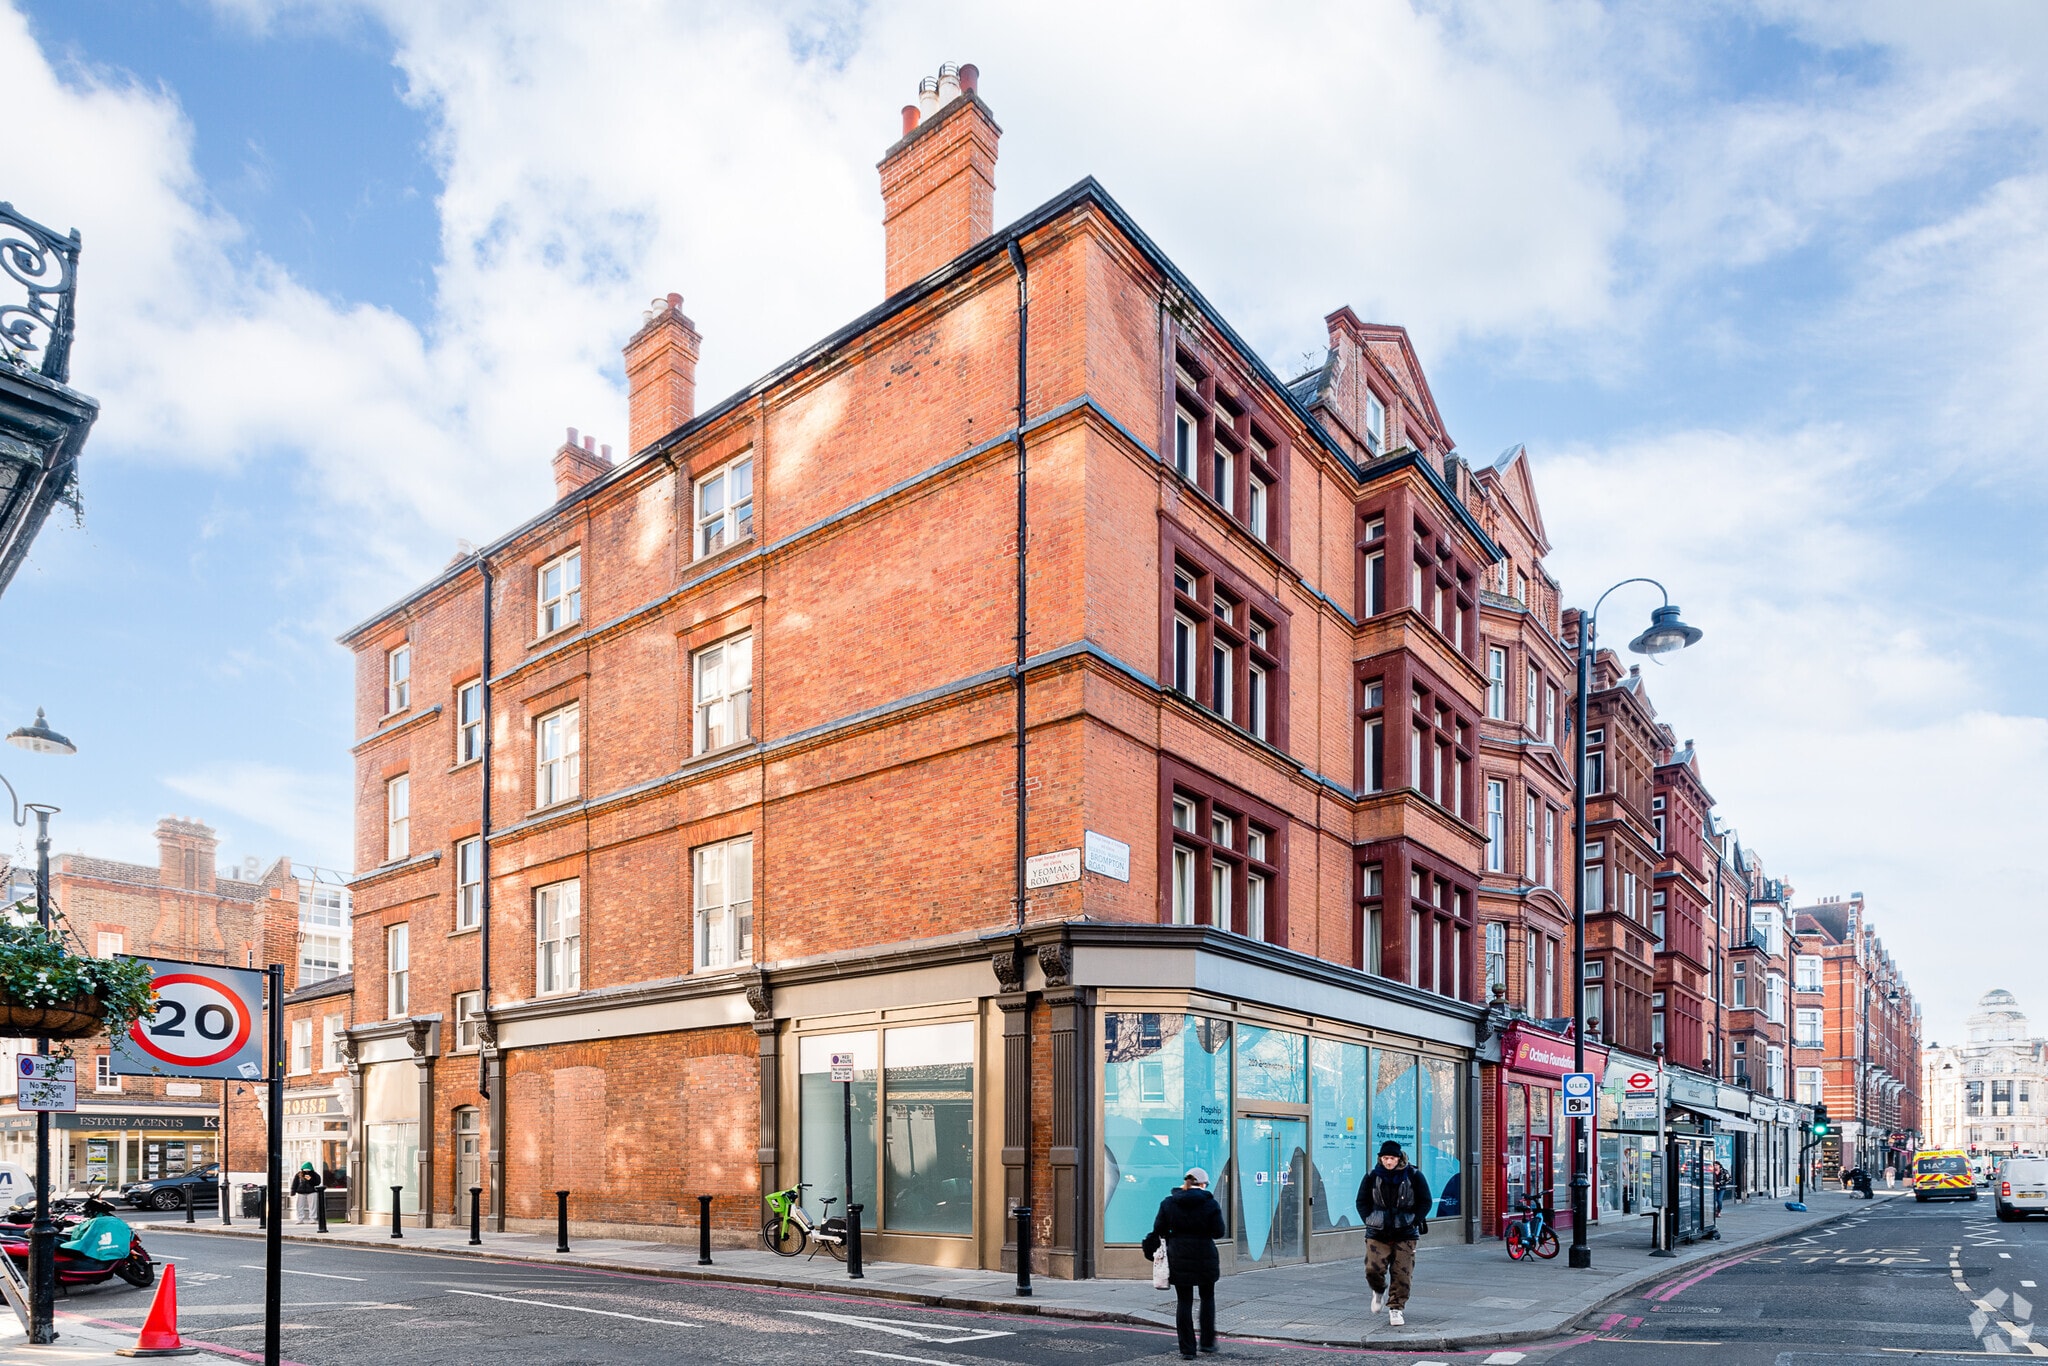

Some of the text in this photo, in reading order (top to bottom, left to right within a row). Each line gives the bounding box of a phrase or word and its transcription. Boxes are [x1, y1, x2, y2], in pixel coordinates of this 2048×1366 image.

[1089, 860, 1106, 872] ROAD
[1090, 852, 1125, 870] BROMPTON
[1032, 863, 1075, 877] YEOMANS
[1030, 876, 1050, 887] ROW
[151, 999, 234, 1041] 20
[1529, 1047, 1549, 1064] Octavia
[29, 1081, 40, 1089] No
[1200, 1105, 1222, 1114] Flagship
[80, 1117, 127, 1126] ESTATE
[132, 1117, 184, 1127] AGENTS
[1789, 1248, 1920, 1256] BUS
[1743, 1256, 1931, 1265] STOP
